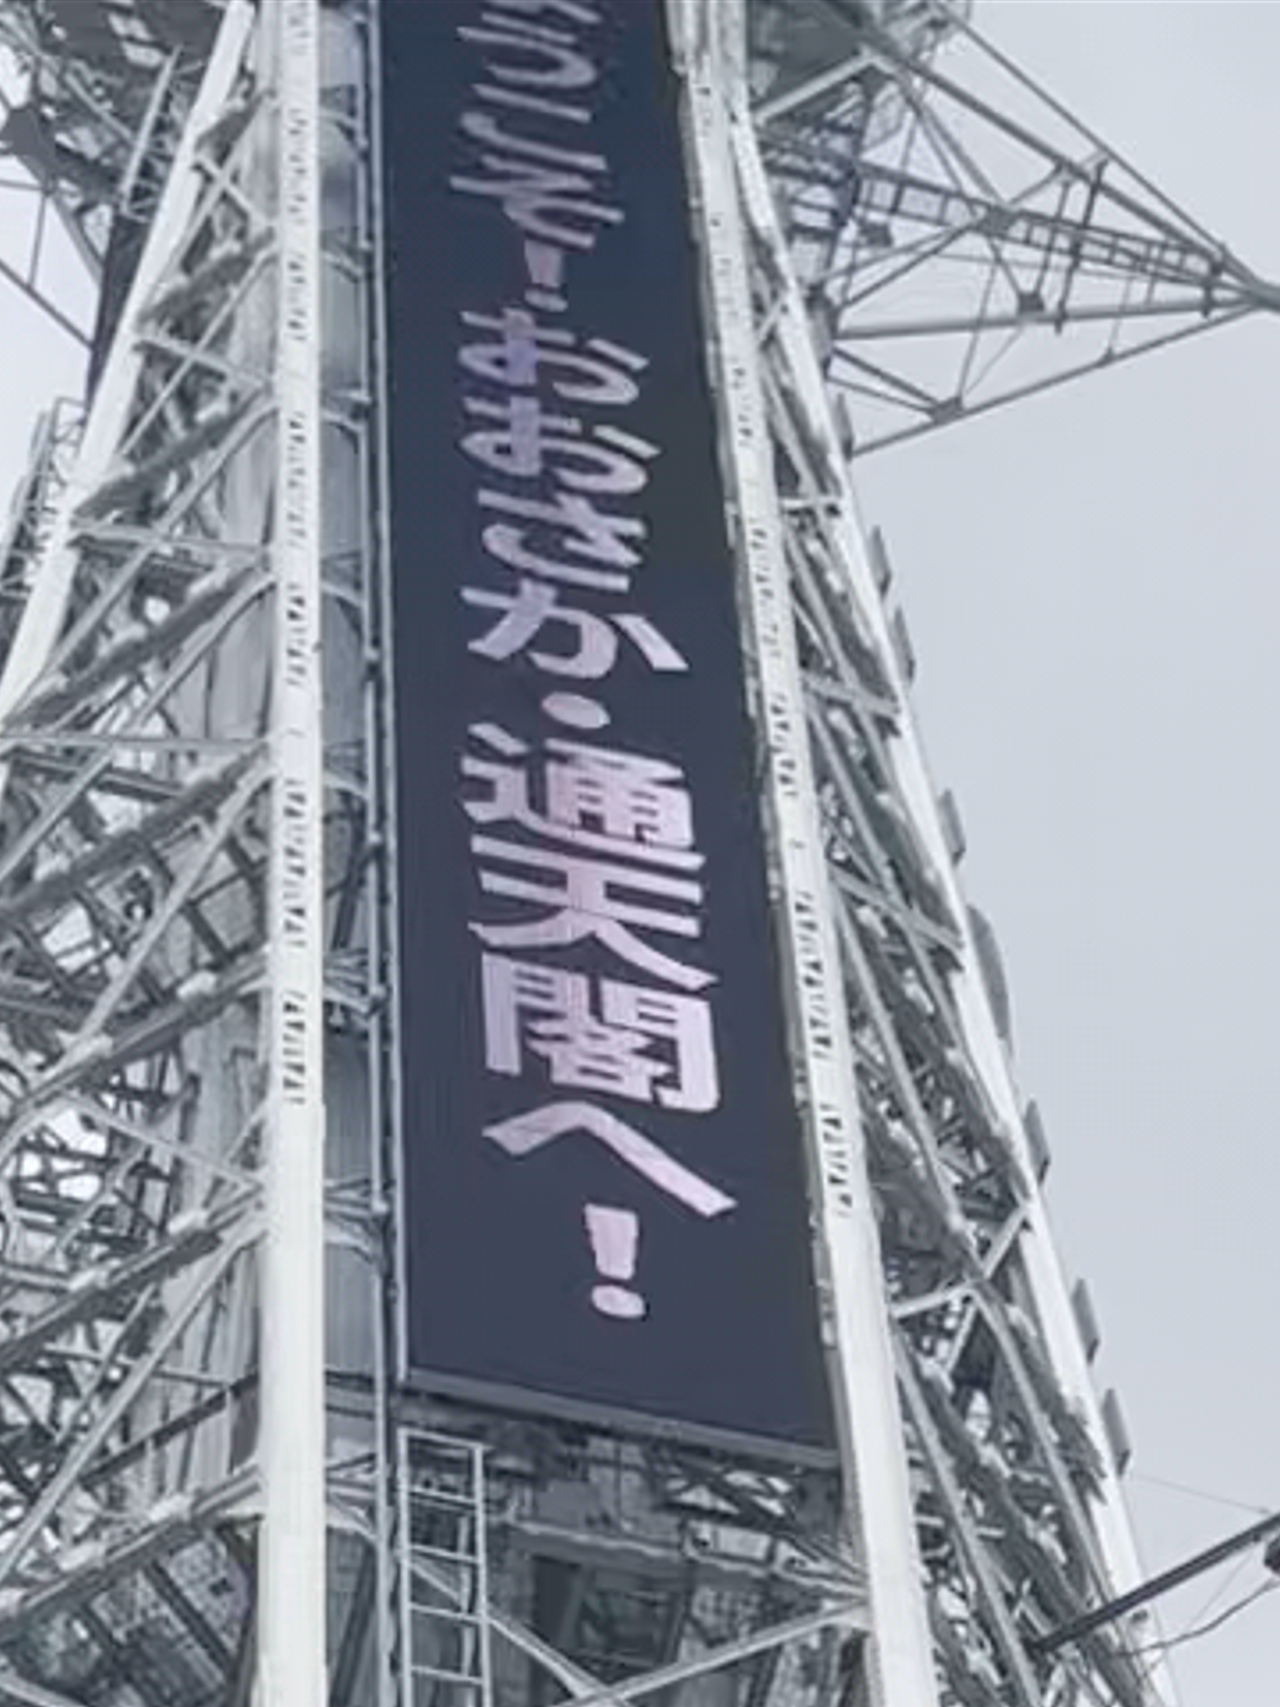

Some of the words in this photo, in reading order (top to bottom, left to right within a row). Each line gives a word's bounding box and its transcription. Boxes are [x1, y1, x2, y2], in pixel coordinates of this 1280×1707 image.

[448, 0, 738, 1320] うこそ!おおさか・通天閣へ!
